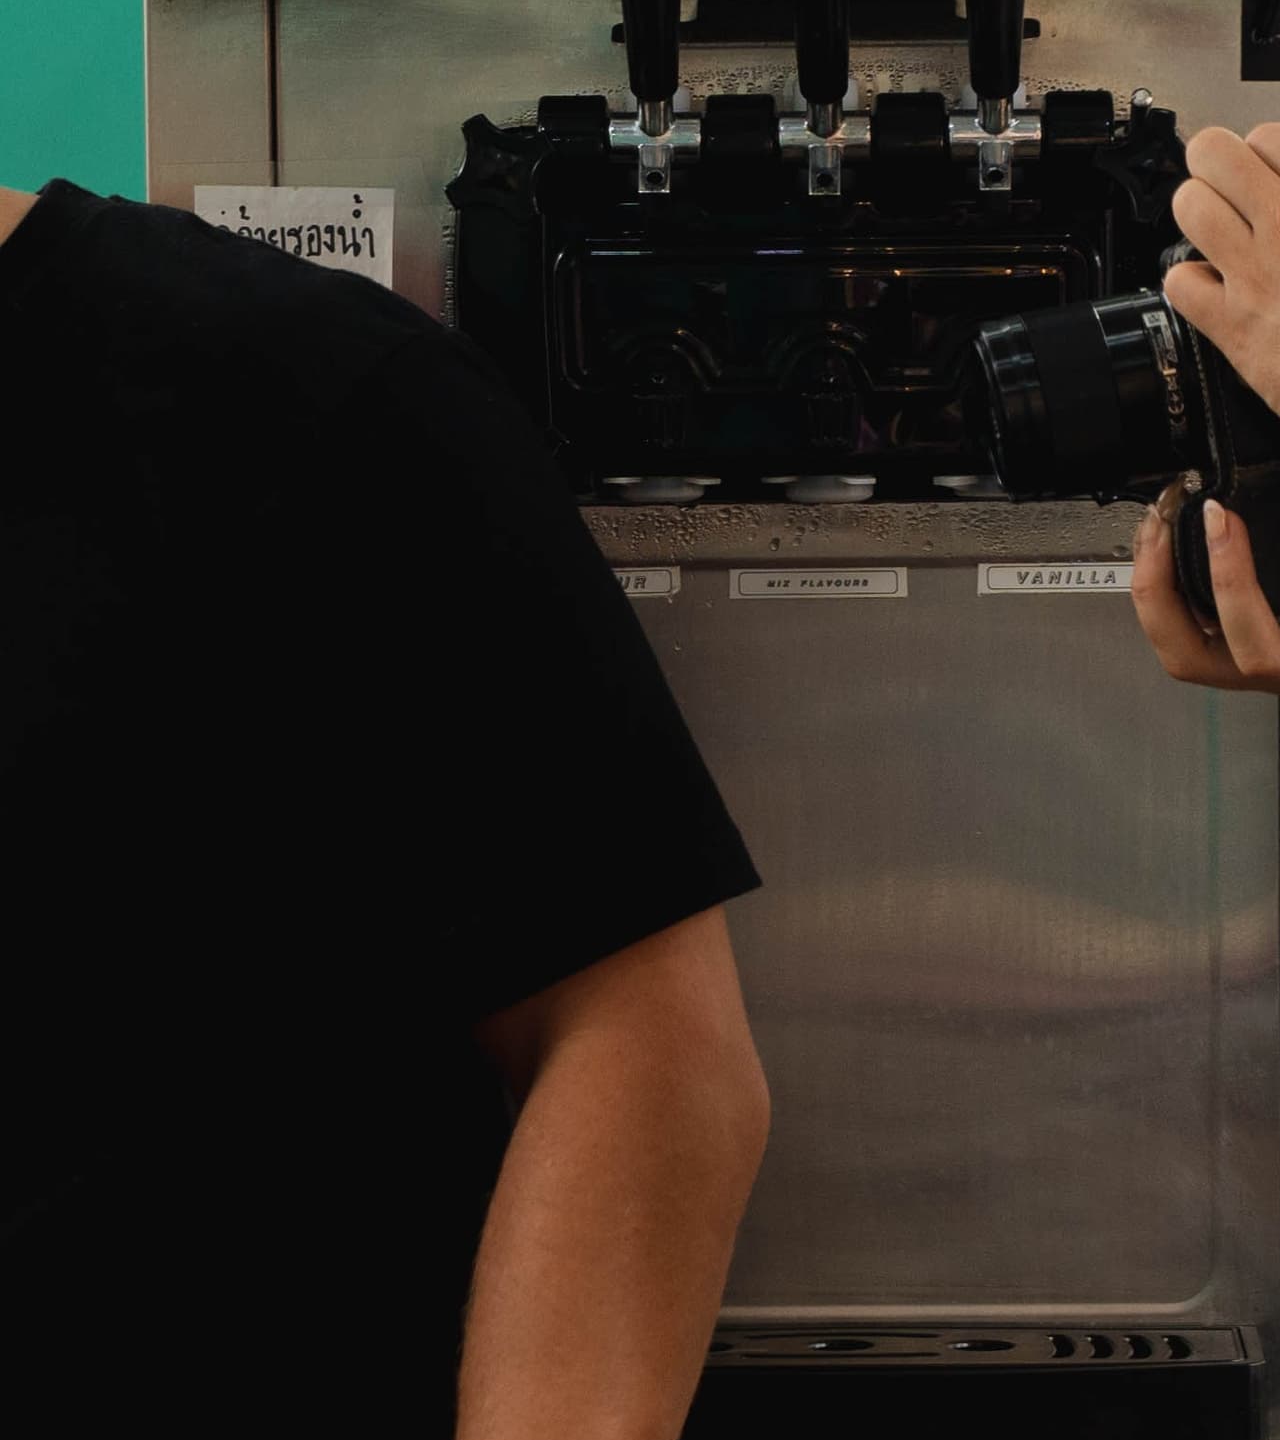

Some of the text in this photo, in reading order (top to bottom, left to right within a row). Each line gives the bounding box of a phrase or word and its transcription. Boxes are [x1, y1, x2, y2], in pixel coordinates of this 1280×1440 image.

[767, 578, 869, 588] MIX FLAVOURS
[1016, 570, 1117, 585] VANILLA
